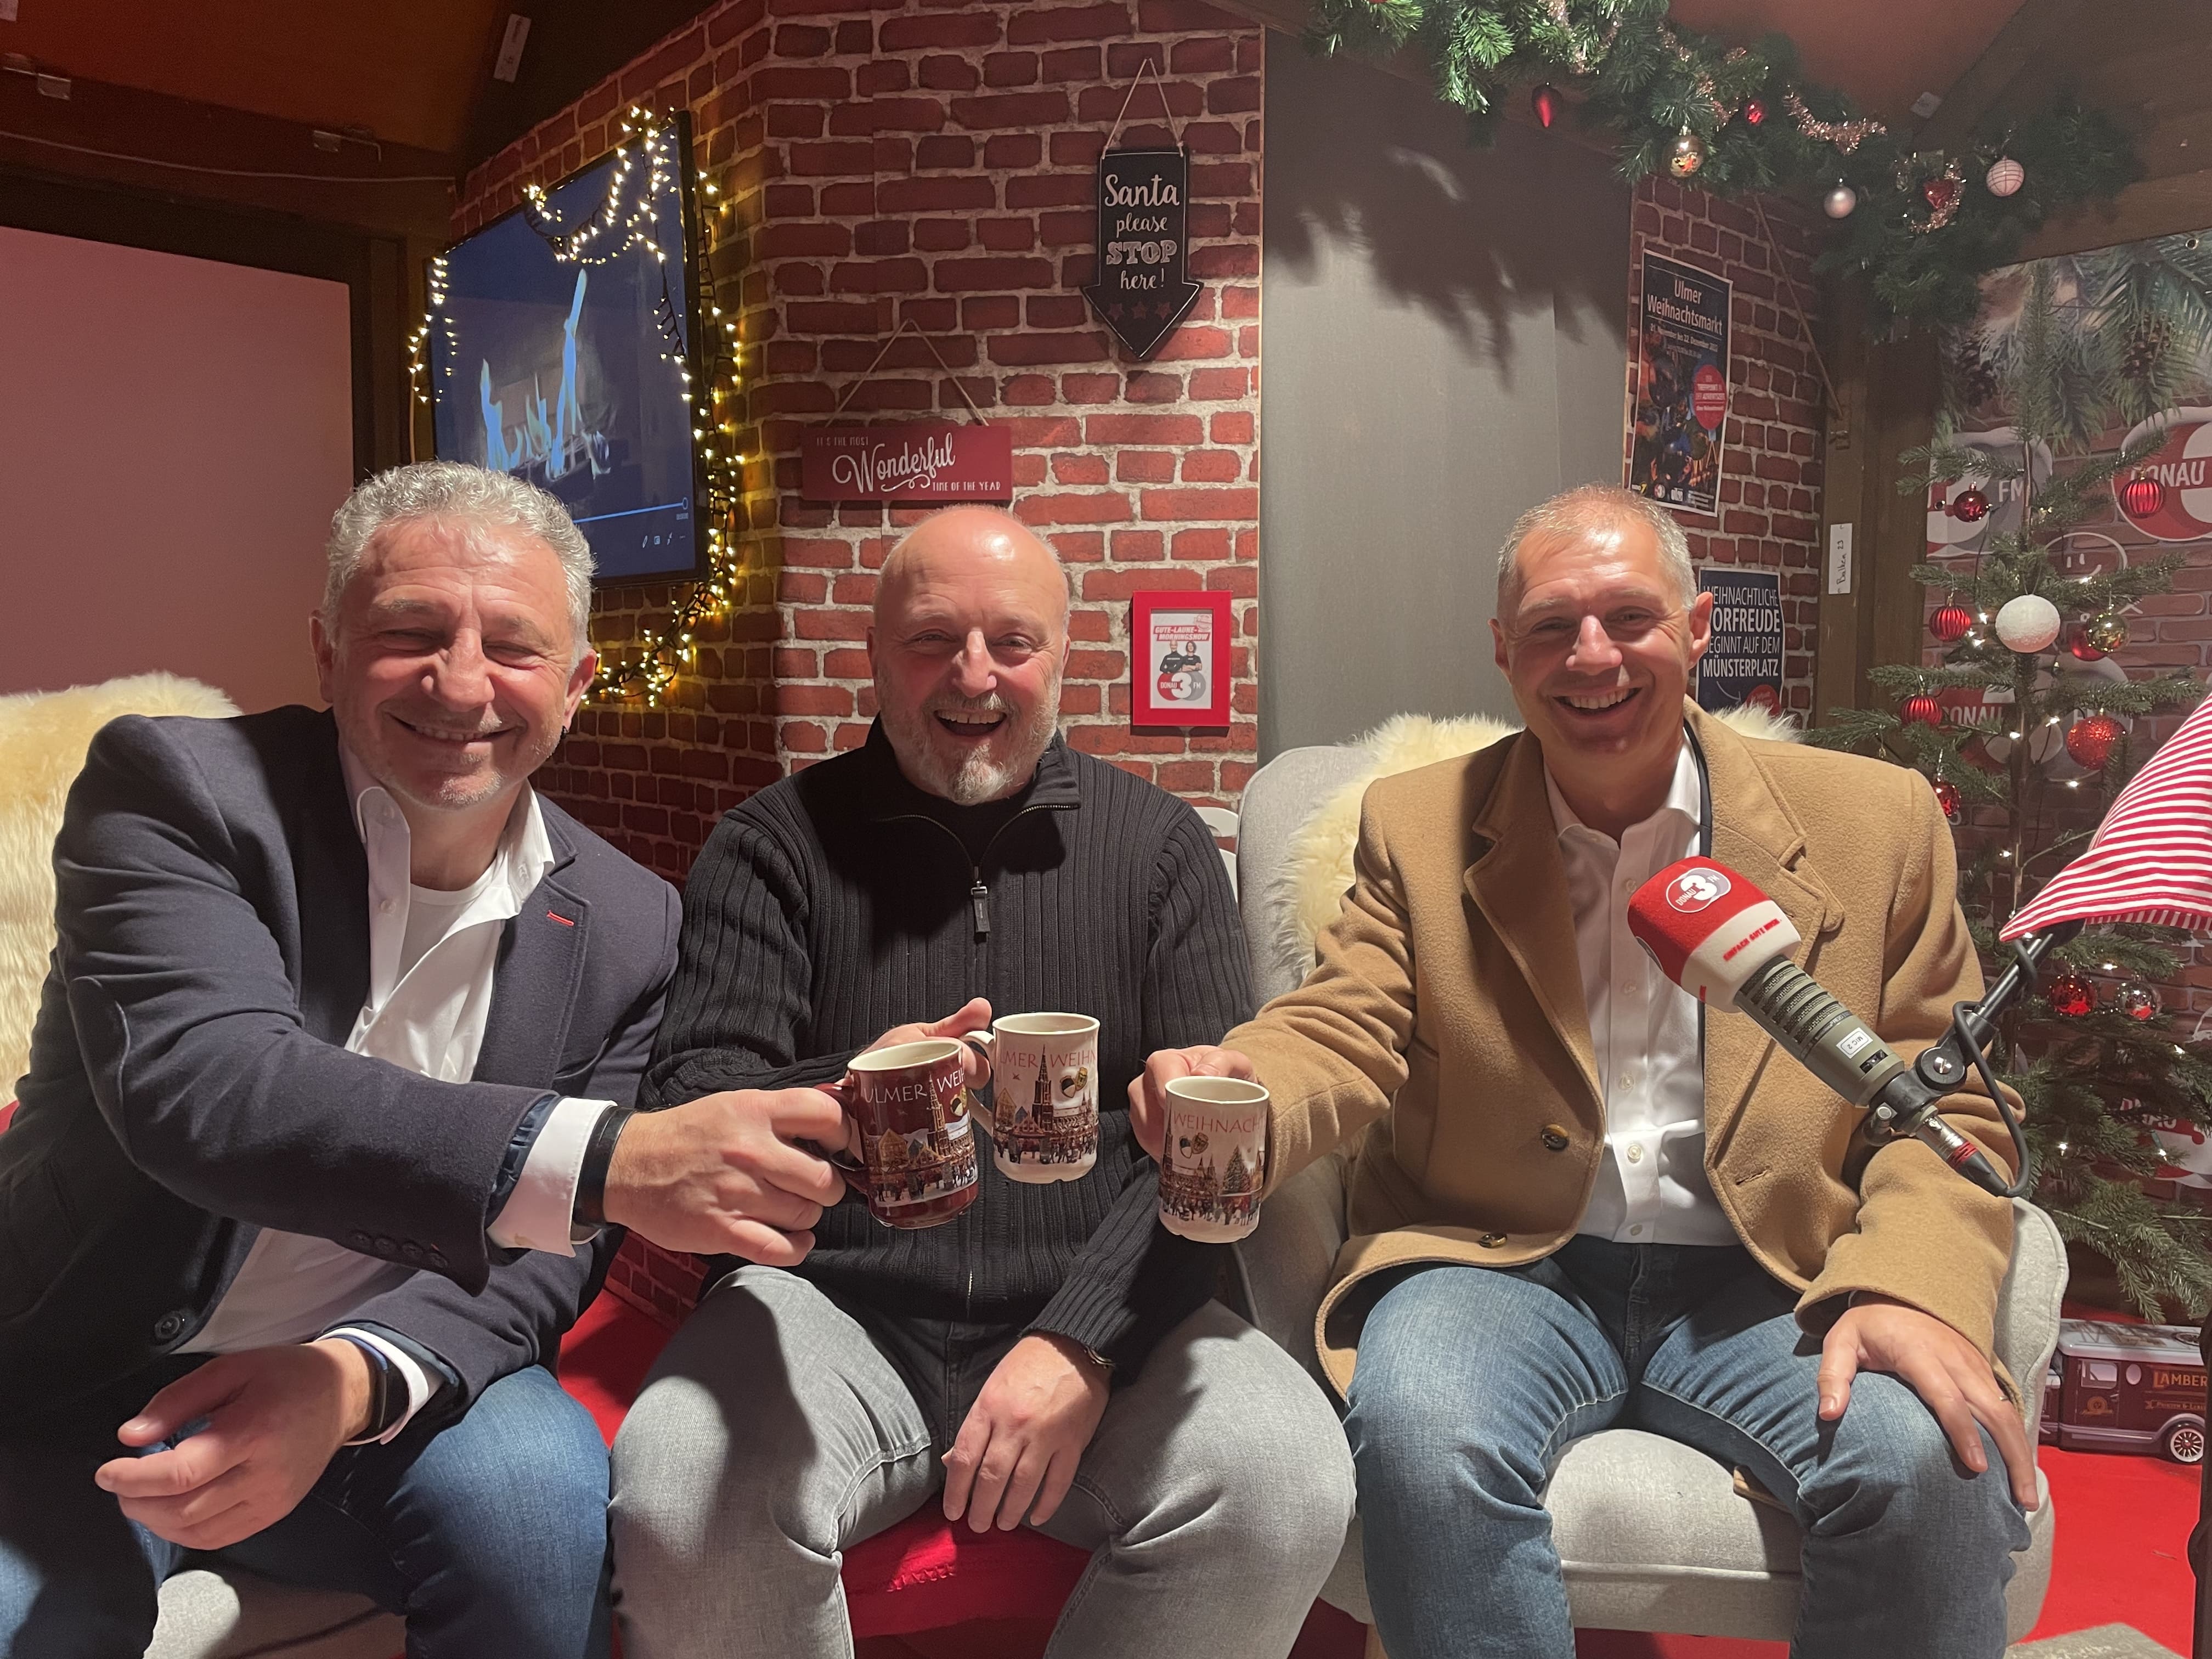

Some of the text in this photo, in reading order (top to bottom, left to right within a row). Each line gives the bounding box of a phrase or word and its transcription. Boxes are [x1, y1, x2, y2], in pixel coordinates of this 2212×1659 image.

[1104, 174, 1180, 207] Santa
[1116, 212, 1168, 238] please
[1106, 240, 1177, 265] STOP
[1120, 268, 1165, 290] here!
[1674, 279, 1702, 304] Ulmer
[1647, 294, 1723, 336] Weihnachtsmarkt
[849, 436, 869, 446] MOST
[832, 432, 956, 494] Wonderful
[933, 481, 1001, 491] TIME OF THE YEAR
[1837, 539, 1844, 550] 23
[1709, 607, 1781, 633] ORFREUDE
[1705, 635, 1780, 654] EGINNT AUF DEM
[1703, 654, 1779, 678] MÜNSTERPLATZ
[1171, 672, 1192, 699] 3
[1675, 874, 1720, 906] DONAU 3 FM
[1852, 1035, 1864, 1046] MIC
[864, 1084, 928, 1103] ULMER
